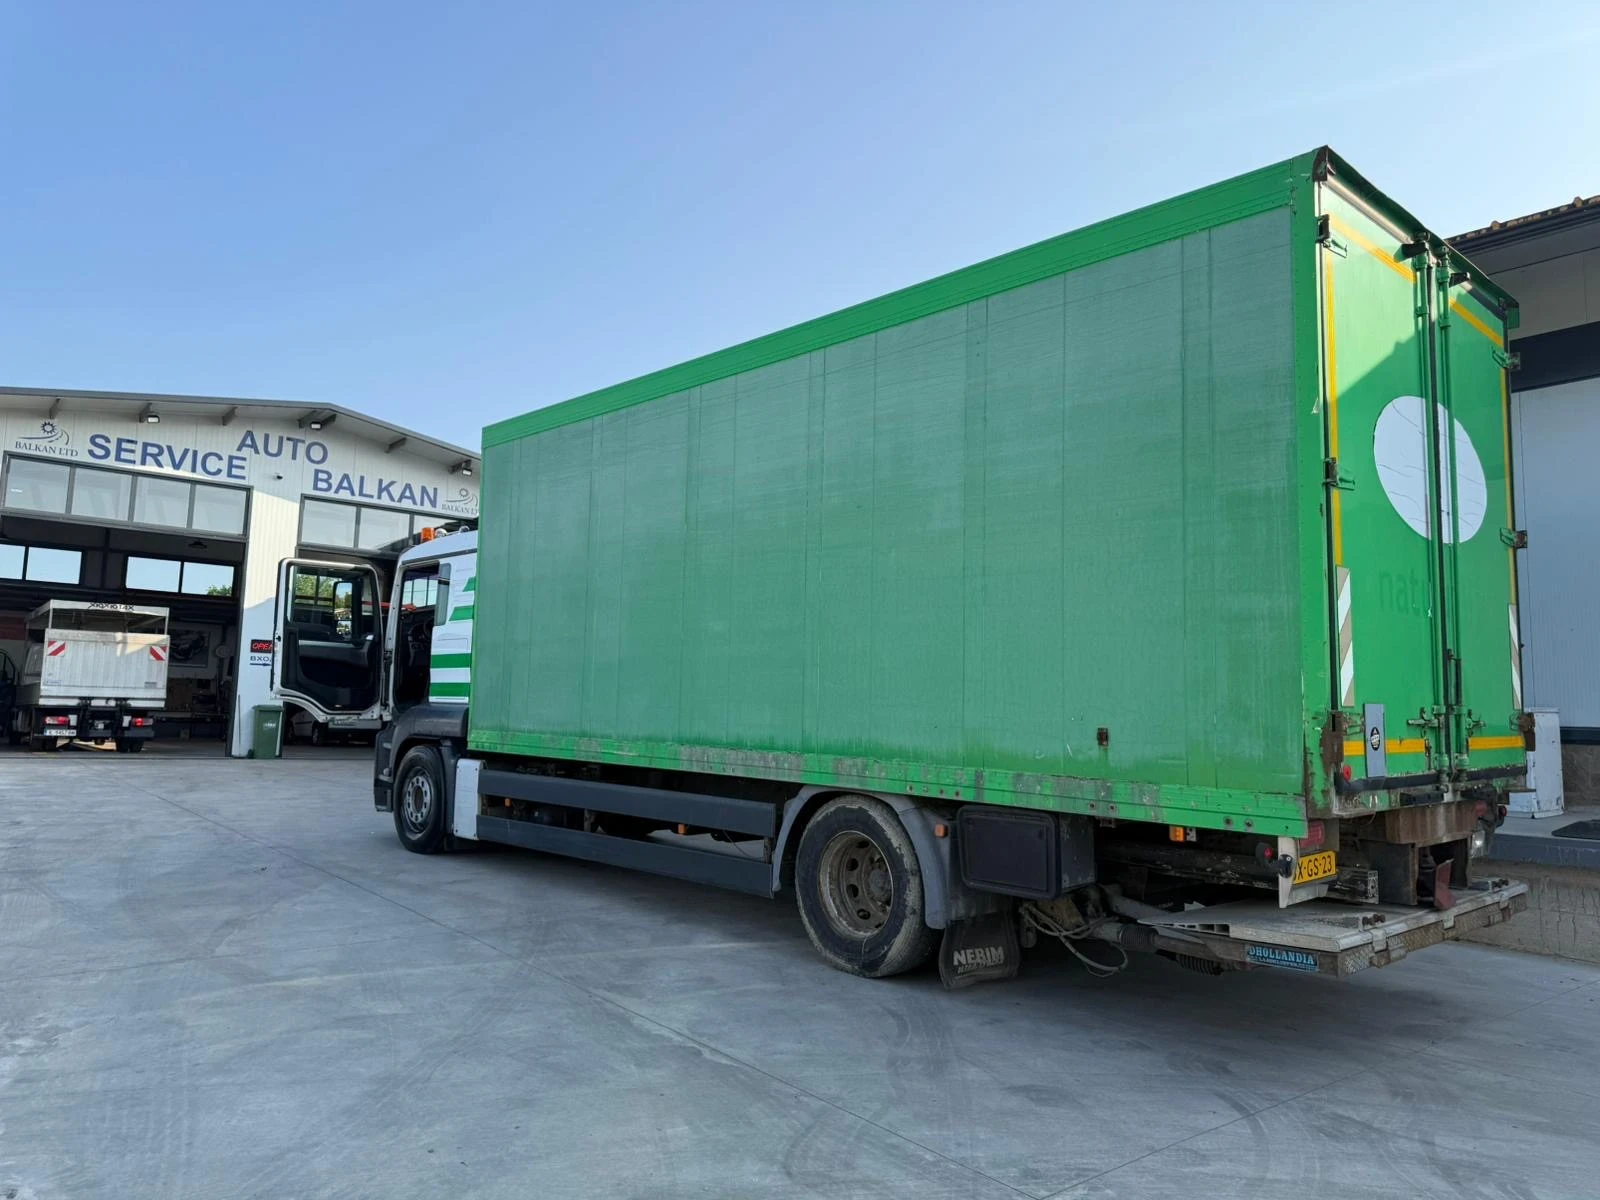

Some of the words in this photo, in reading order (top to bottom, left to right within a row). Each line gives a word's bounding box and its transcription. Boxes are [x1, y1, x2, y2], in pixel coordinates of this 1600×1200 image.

[15, 440, 57, 455] BALKAN
[59, 446, 79, 458] LTD
[87, 433, 247, 481] SERVICE
[236, 429, 329, 465] AUTO
[312, 468, 438, 509] BALKAN
[1248, 945, 1315, 965] DHOLLANDIA
